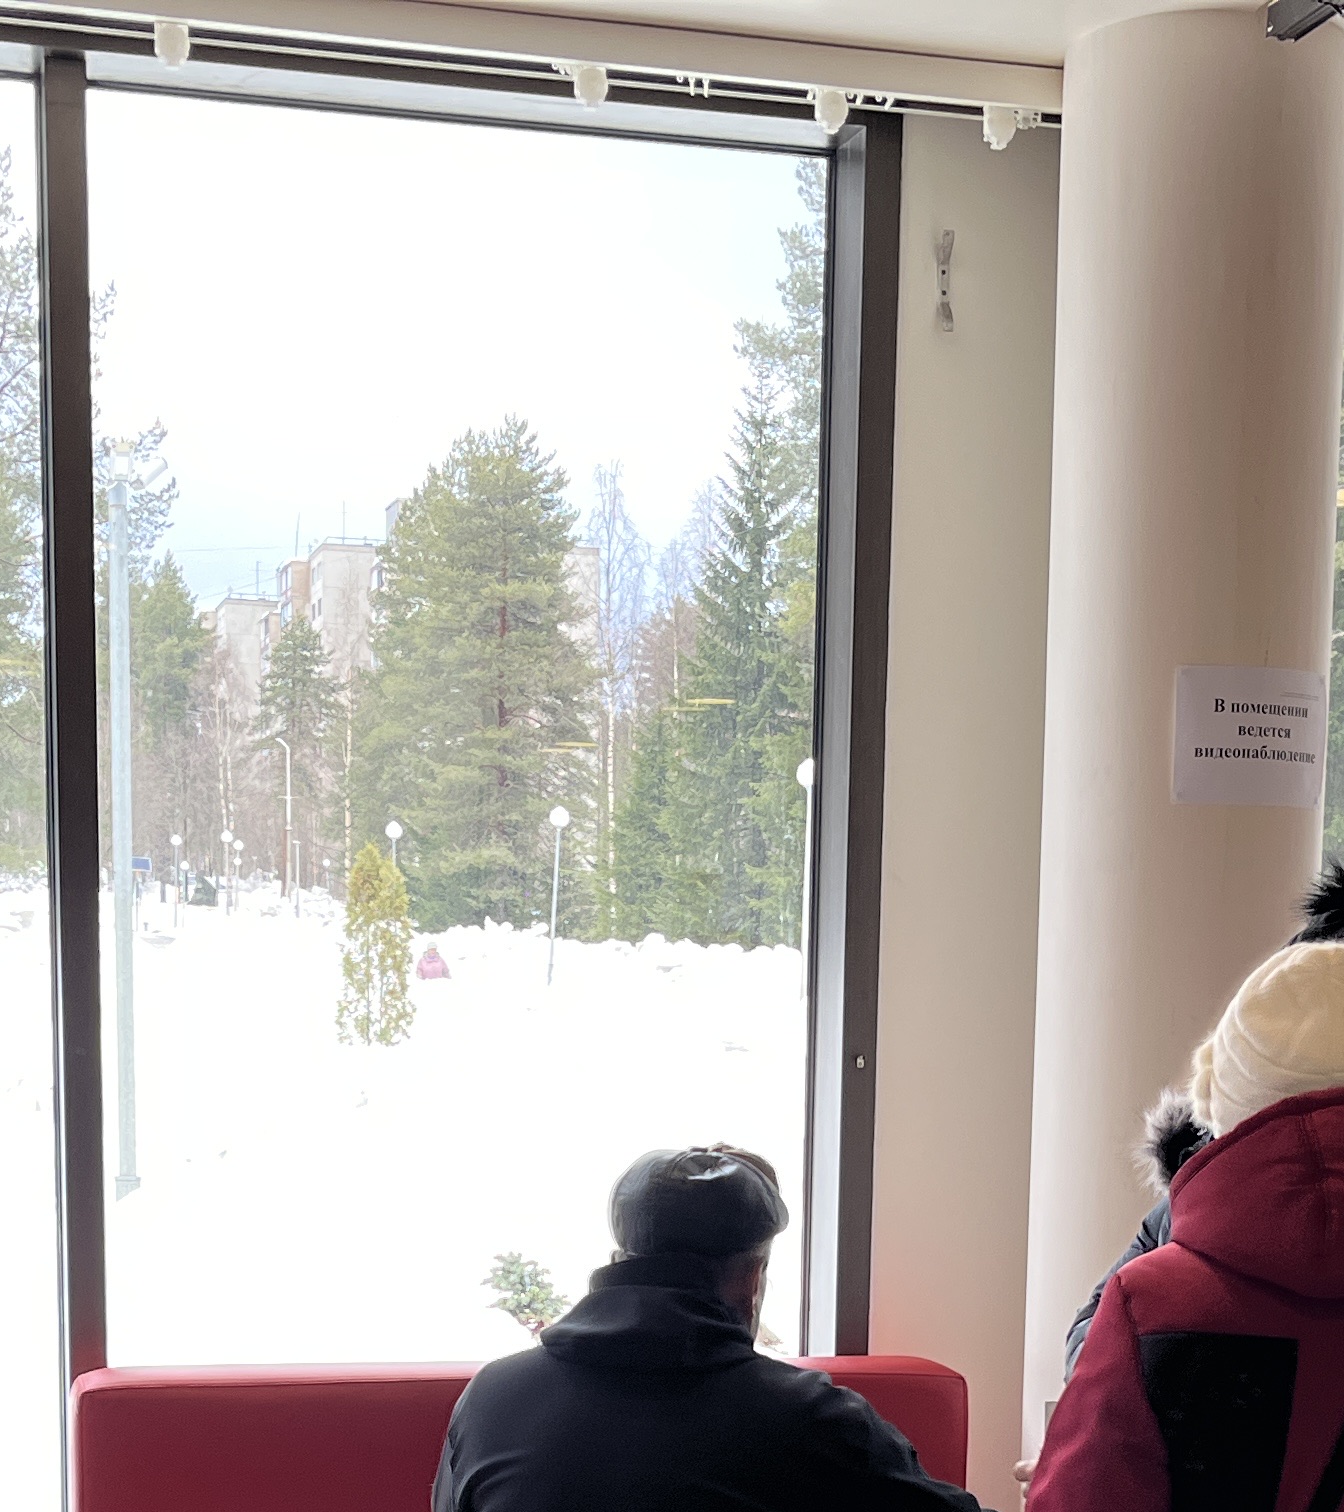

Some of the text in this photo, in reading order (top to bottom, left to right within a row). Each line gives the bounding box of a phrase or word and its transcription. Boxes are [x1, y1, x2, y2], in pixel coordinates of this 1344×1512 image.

[1213, 698, 1309, 719] В помещении
[1238, 724, 1292, 739] ведется
[1193, 745, 1316, 765] видеонаблюдение
